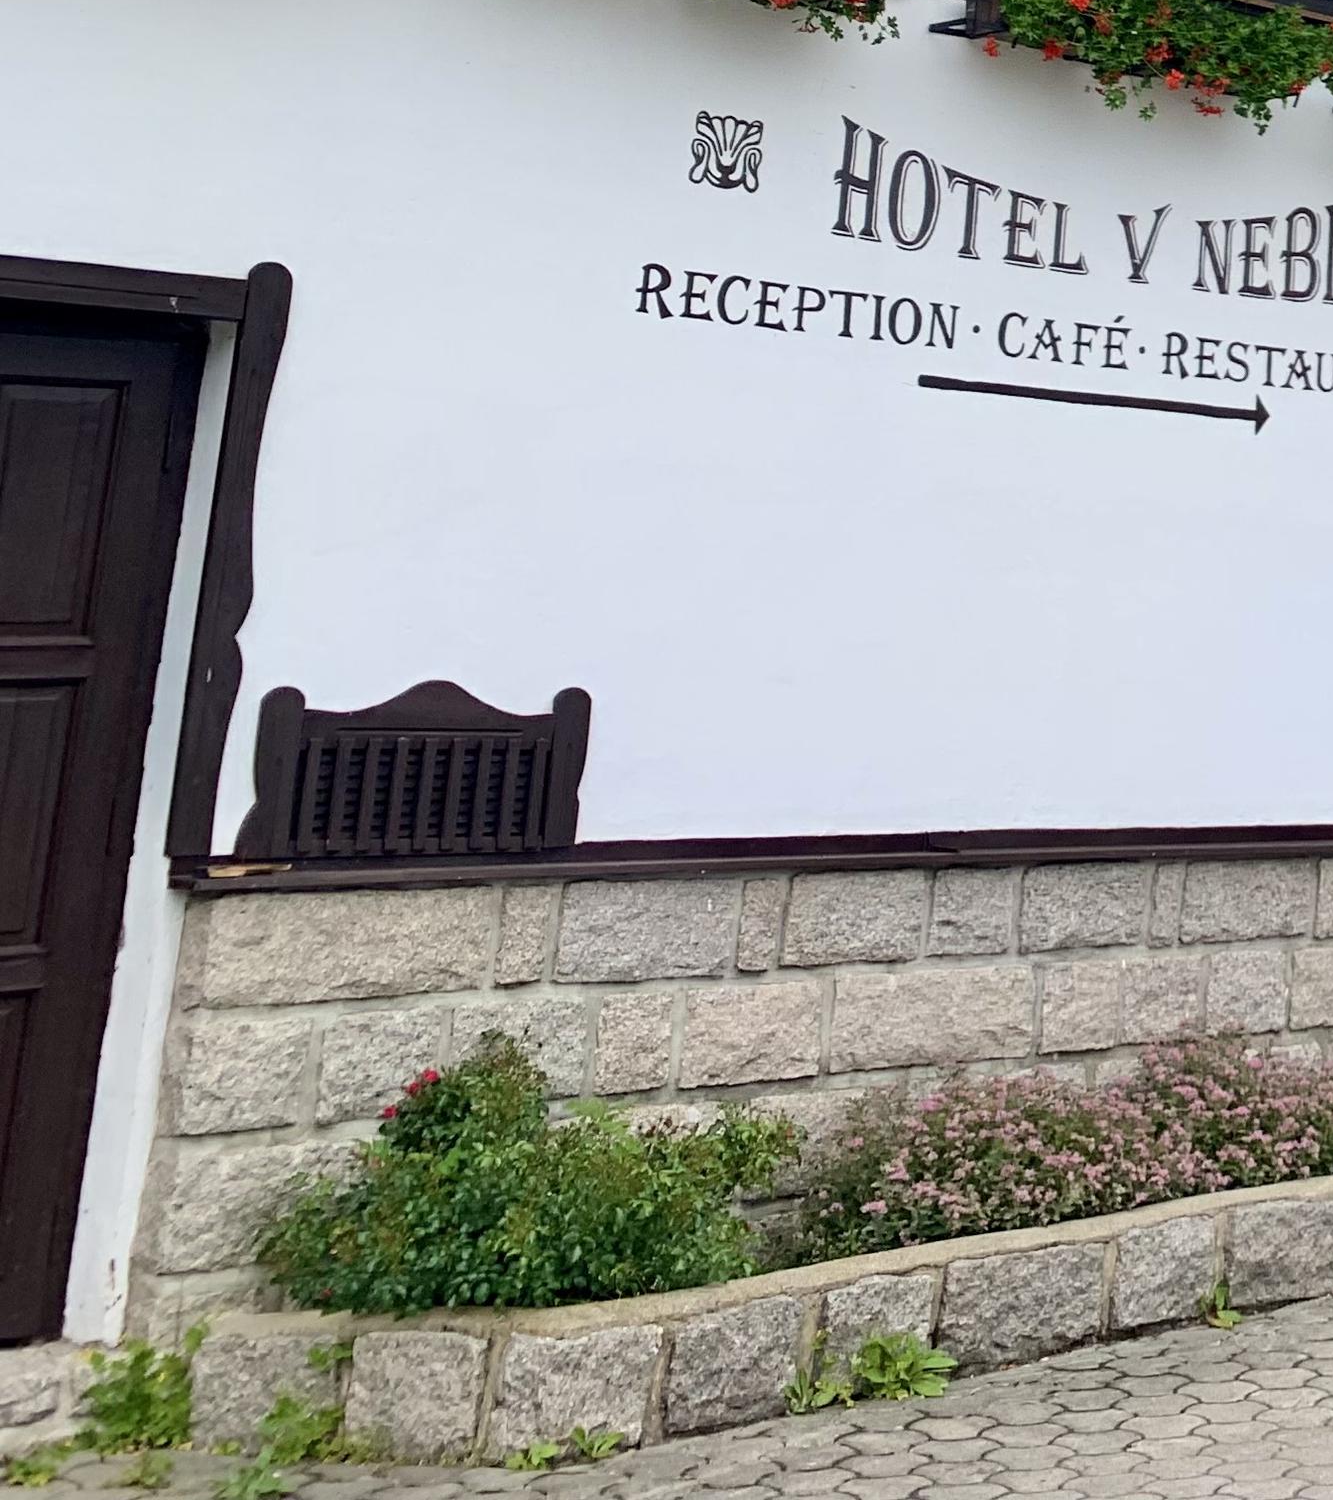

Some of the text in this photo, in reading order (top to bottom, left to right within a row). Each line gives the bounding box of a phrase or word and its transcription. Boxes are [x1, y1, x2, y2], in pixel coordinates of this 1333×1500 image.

[830, 114, 1090, 276] HOTEL
[1116, 203, 1173, 285] V
[634, 262, 961, 350] RECEPTION
[997, 314, 1133, 371] CAFÉ
